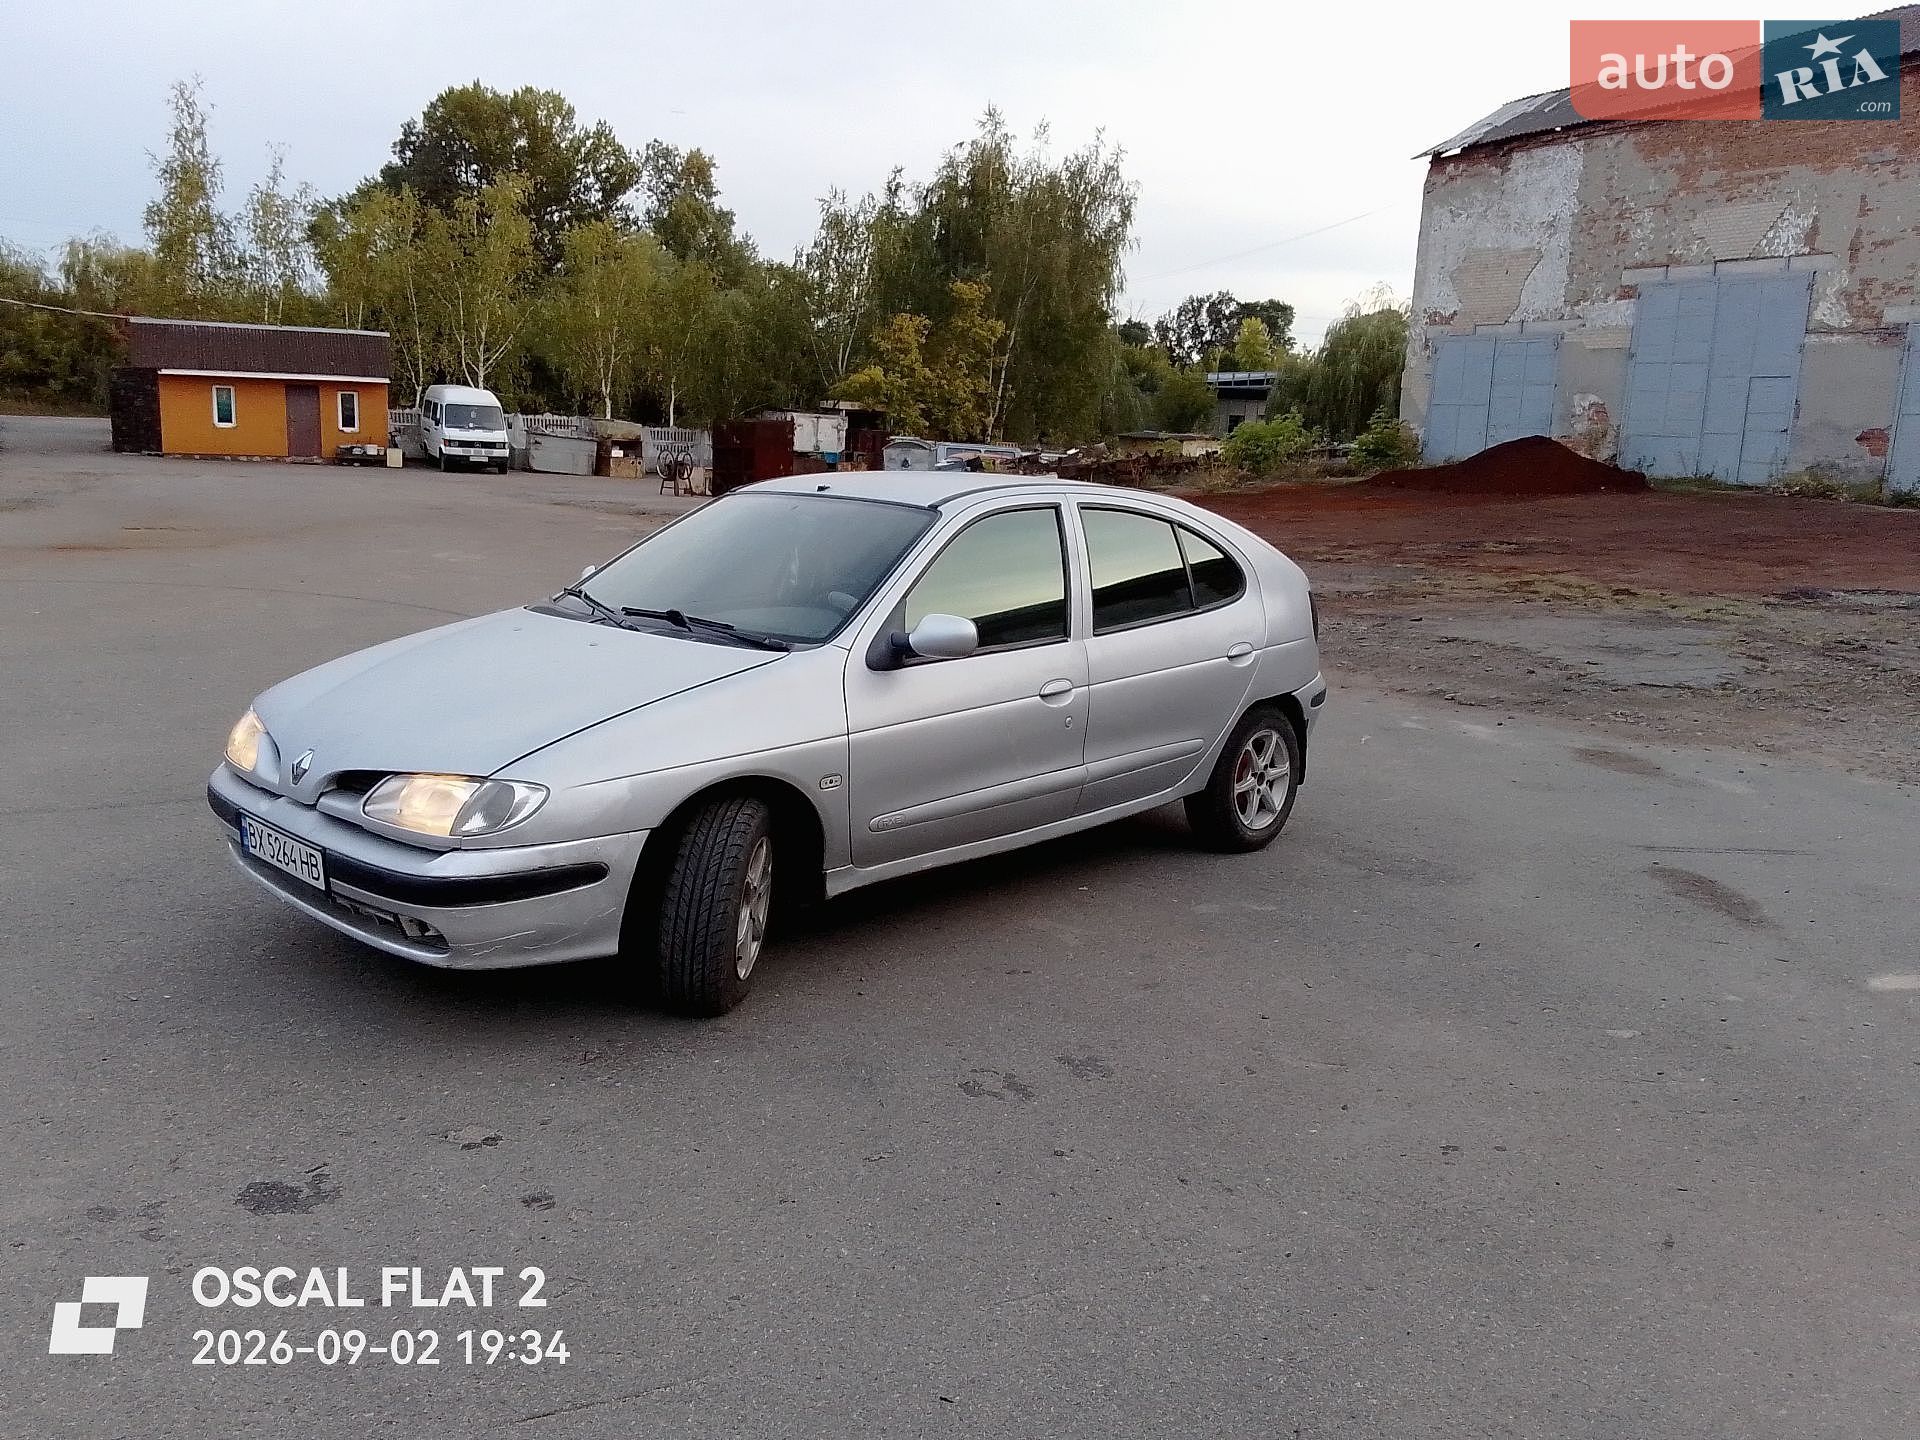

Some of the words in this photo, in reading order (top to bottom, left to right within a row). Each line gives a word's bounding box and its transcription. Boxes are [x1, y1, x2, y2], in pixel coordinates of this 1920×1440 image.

[247, 821, 266, 856] BX
[267, 832, 298, 872] 5264
[299, 847, 321, 882] HB
